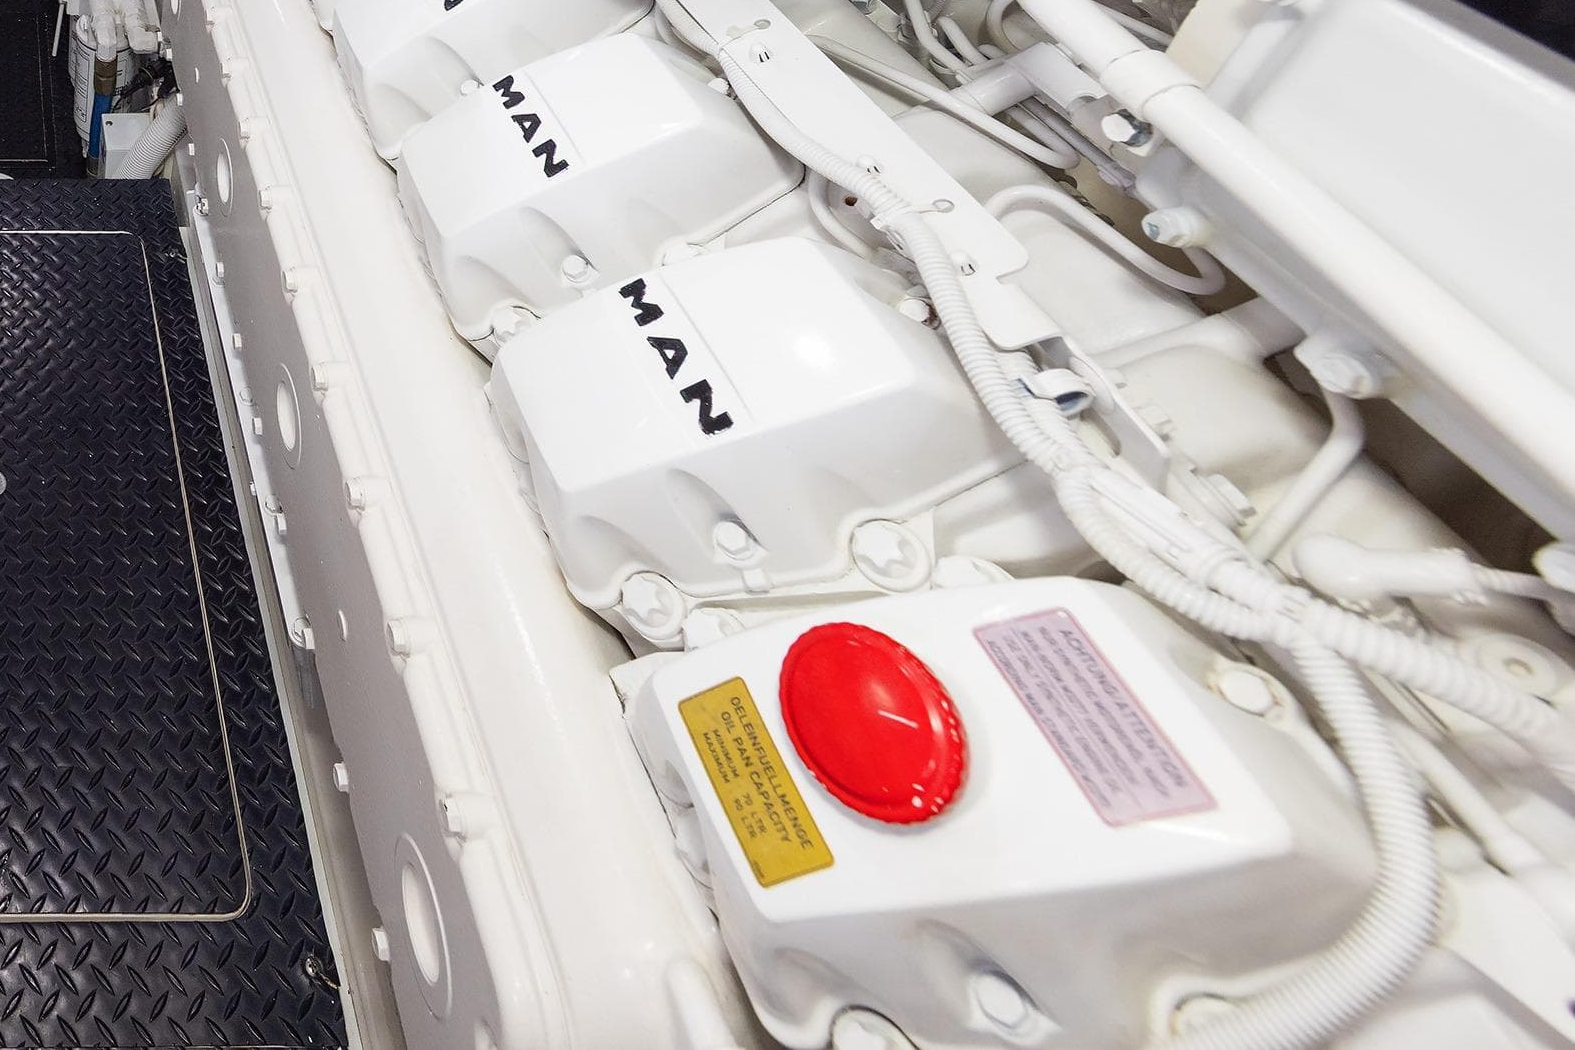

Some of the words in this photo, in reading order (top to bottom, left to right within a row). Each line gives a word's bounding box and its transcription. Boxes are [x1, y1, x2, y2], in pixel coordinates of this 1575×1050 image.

[492, 74, 569, 178] MAN
[618, 278, 734, 435] MAN
[701, 731, 731, 783] MAXIMUM
[711, 728, 741, 778] MINIMUM
[719, 709, 738, 734] OIL
[731, 736, 754, 767] PAN
[747, 769, 792, 845] CAPACITY
[727, 695, 815, 851] OELEINFUELLMENGE
